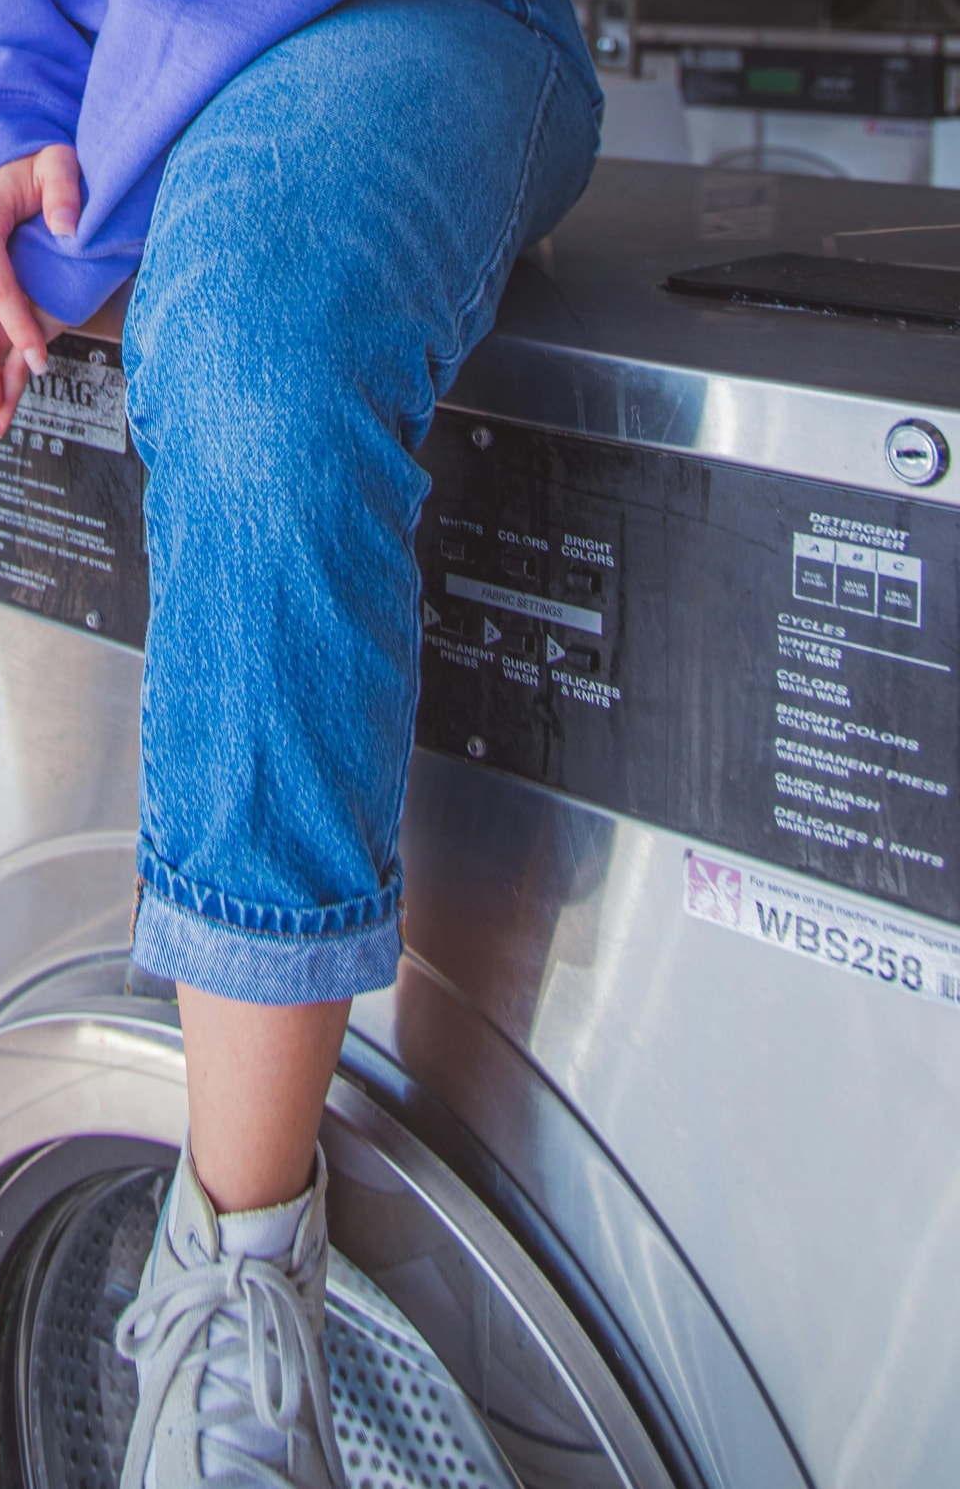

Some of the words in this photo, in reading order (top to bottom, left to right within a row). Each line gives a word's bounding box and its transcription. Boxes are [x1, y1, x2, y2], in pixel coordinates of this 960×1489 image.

[39, 417, 86, 436] WASHER
[439, 515, 484, 535] WHITES
[809, 512, 911, 539] DETERGENT
[812, 523, 906, 551] DISPENSER
[498, 529, 550, 552] COLORS
[564, 533, 613, 554] BRIGHT
[810, 544, 820, 553] A
[561, 545, 615, 568] COLORS
[893, 561, 905, 571] C
[481, 587, 515, 606] FABRIC
[517, 596, 564, 618] SETTINGS
[486, 626, 495, 640] 2
[778, 613, 847, 638] CYCLES
[424, 634, 496, 663] PERMANENT
[440, 650, 479, 670] PRESS
[550, 643, 557, 656] 3
[778, 634, 842, 659] WHITES
[778, 646, 803, 660] HOT
[805, 651, 840, 669] WASH
[501, 655, 540, 676] QUICK
[503, 667, 539, 687] WASH
[552, 670, 621, 700] DELICATES
[775, 669, 849, 696] COLORS
[777, 679, 814, 698] WARM
[816, 688, 851, 708] WASH
[561, 686, 570, 697] &
[573, 688, 611, 709] KNITS
[775, 703, 842, 728] BRIGHT
[844, 722, 920, 752] COLORS
[778, 716, 810, 732] COLD
[812, 724, 847, 743] WASH
[775, 736, 884, 776] PERMANENT
[886, 770, 949, 797] PRESS
[776, 748, 812, 768] WARM
[814, 758, 850, 779] WASH
[775, 772, 826, 795] QUICK
[830, 787, 881, 813] WASH
[776, 781, 812, 801] WARM
[814, 792, 849, 813] WASH
[774, 805, 869, 845] DELICATES
[873, 837, 884, 850] &
[889, 842, 945, 869] KNITS
[775, 816, 812, 838] WARM
[813, 828, 849, 849] WASH
[749, 874, 766, 888] For
[767, 882, 801, 901] service
[802, 892, 815, 906] on
[816, 898, 834, 912] this
[837, 903, 879, 927] machine,
[882, 920, 916, 940] please
[918, 932, 950, 953] report
[755, 900, 924, 992] WBS258
